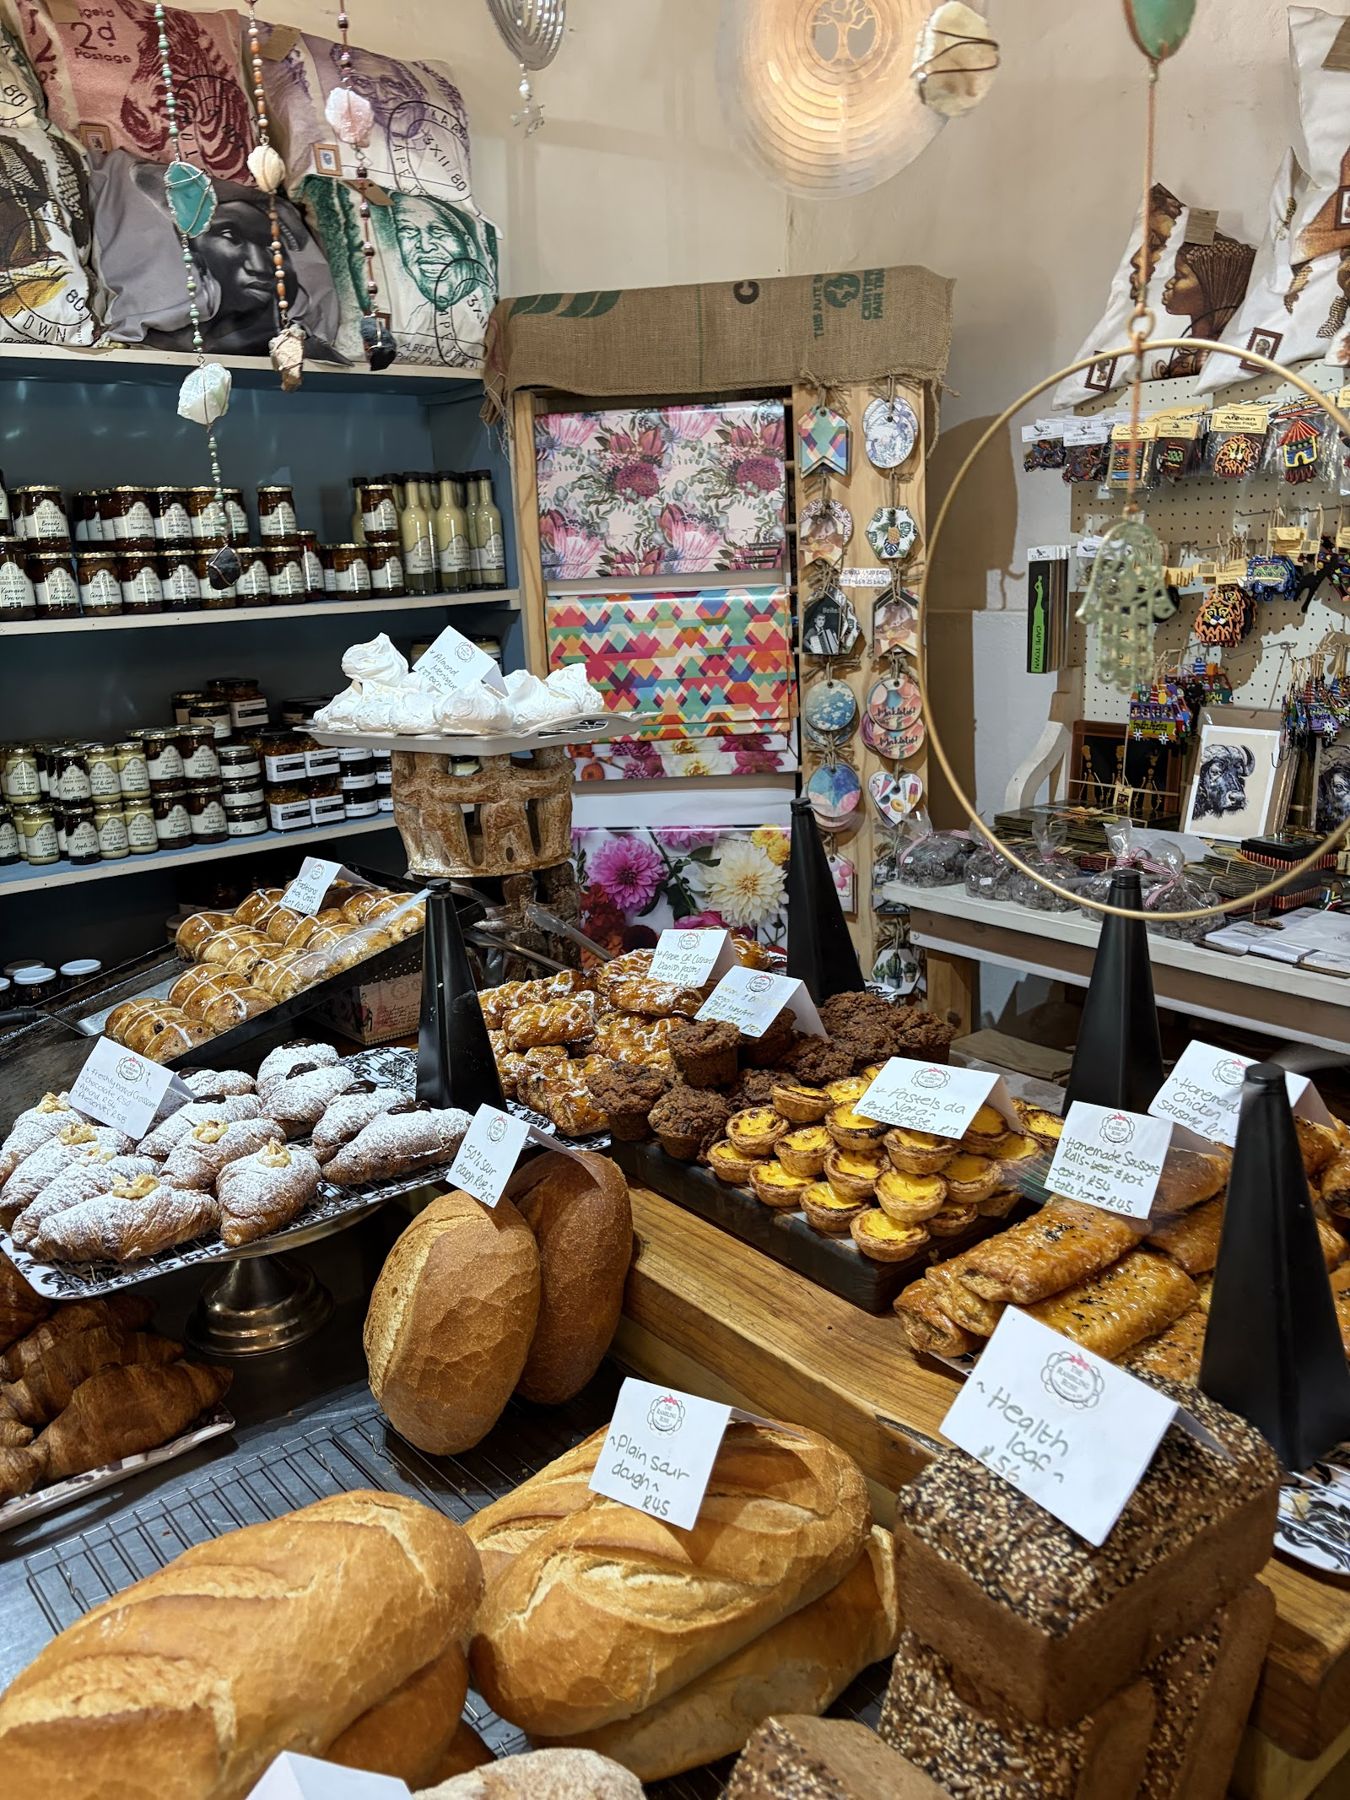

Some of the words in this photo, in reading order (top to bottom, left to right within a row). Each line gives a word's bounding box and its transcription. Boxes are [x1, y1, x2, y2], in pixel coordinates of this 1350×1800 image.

[74, 47, 131, 63] Postage
[65, 289, 86, 311] 80
[888, 1088, 941, 1110] Pastels
[944, 1102, 966, 1114] da
[890, 1101, 928, 1116] Nata
[1173, 1092, 1222, 1120] Chicken
[1179, 1078, 1240, 1114] Homemad
[863, 1100, 932, 1126] Portuguese
[1066, 1136, 1122, 1164] Homemade
[1122, 1150, 1162, 1178] Sausage
[1106, 1198, 1134, 1213] R45
[986, 1386, 1070, 1457] Health
[615, 1434, 648, 1466] Plain
[1006, 1431, 1052, 1473] loaf
[611, 1460, 650, 1490] dough
[642, 1494, 671, 1517] R45
